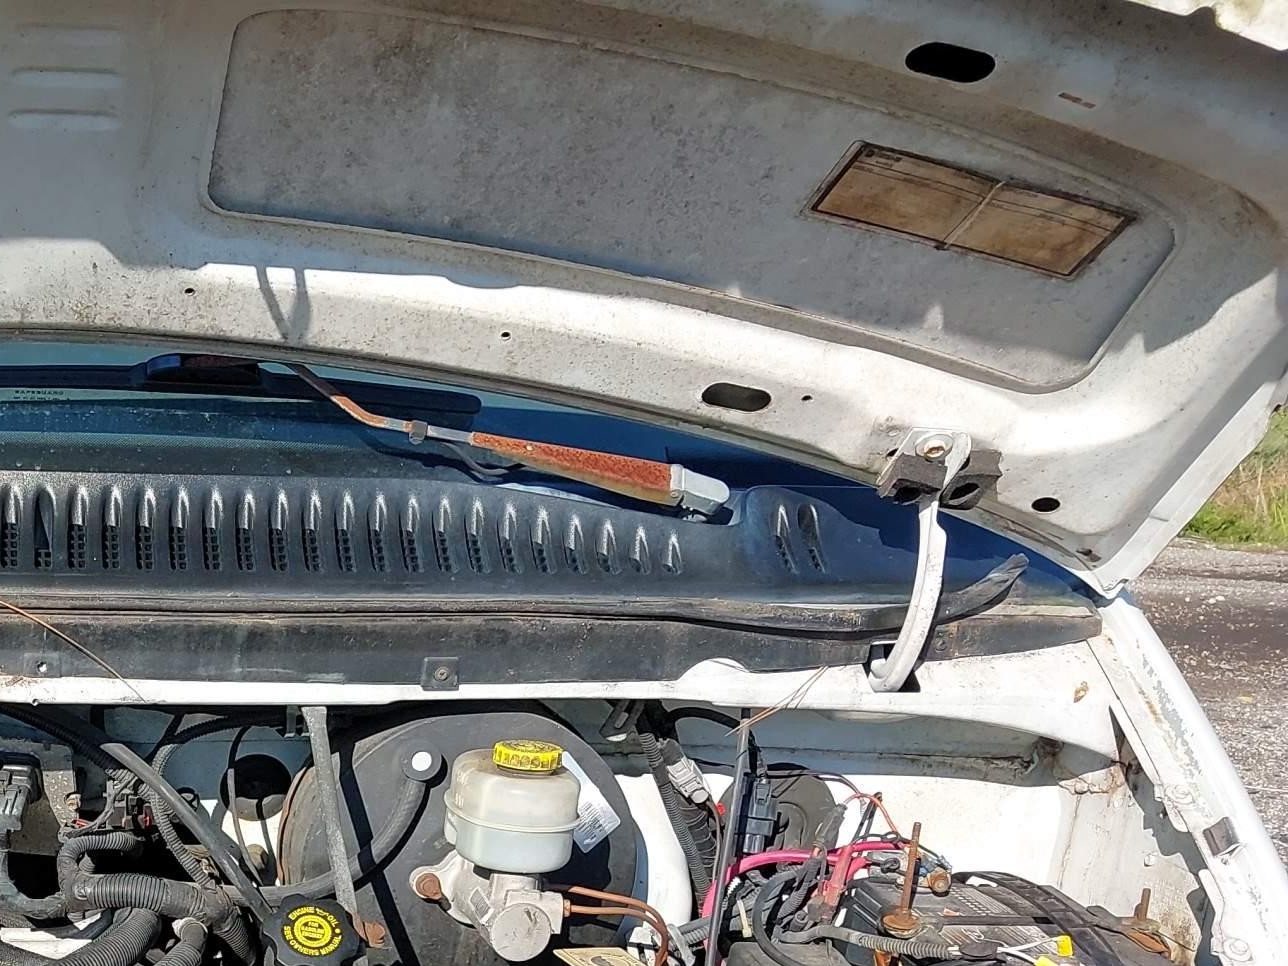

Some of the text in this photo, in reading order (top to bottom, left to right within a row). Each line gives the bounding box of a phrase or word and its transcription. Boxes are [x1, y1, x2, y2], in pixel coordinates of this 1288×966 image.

[288, 906, 340, 928] ENGINE OIL
[283, 925, 294, 941] SEE
